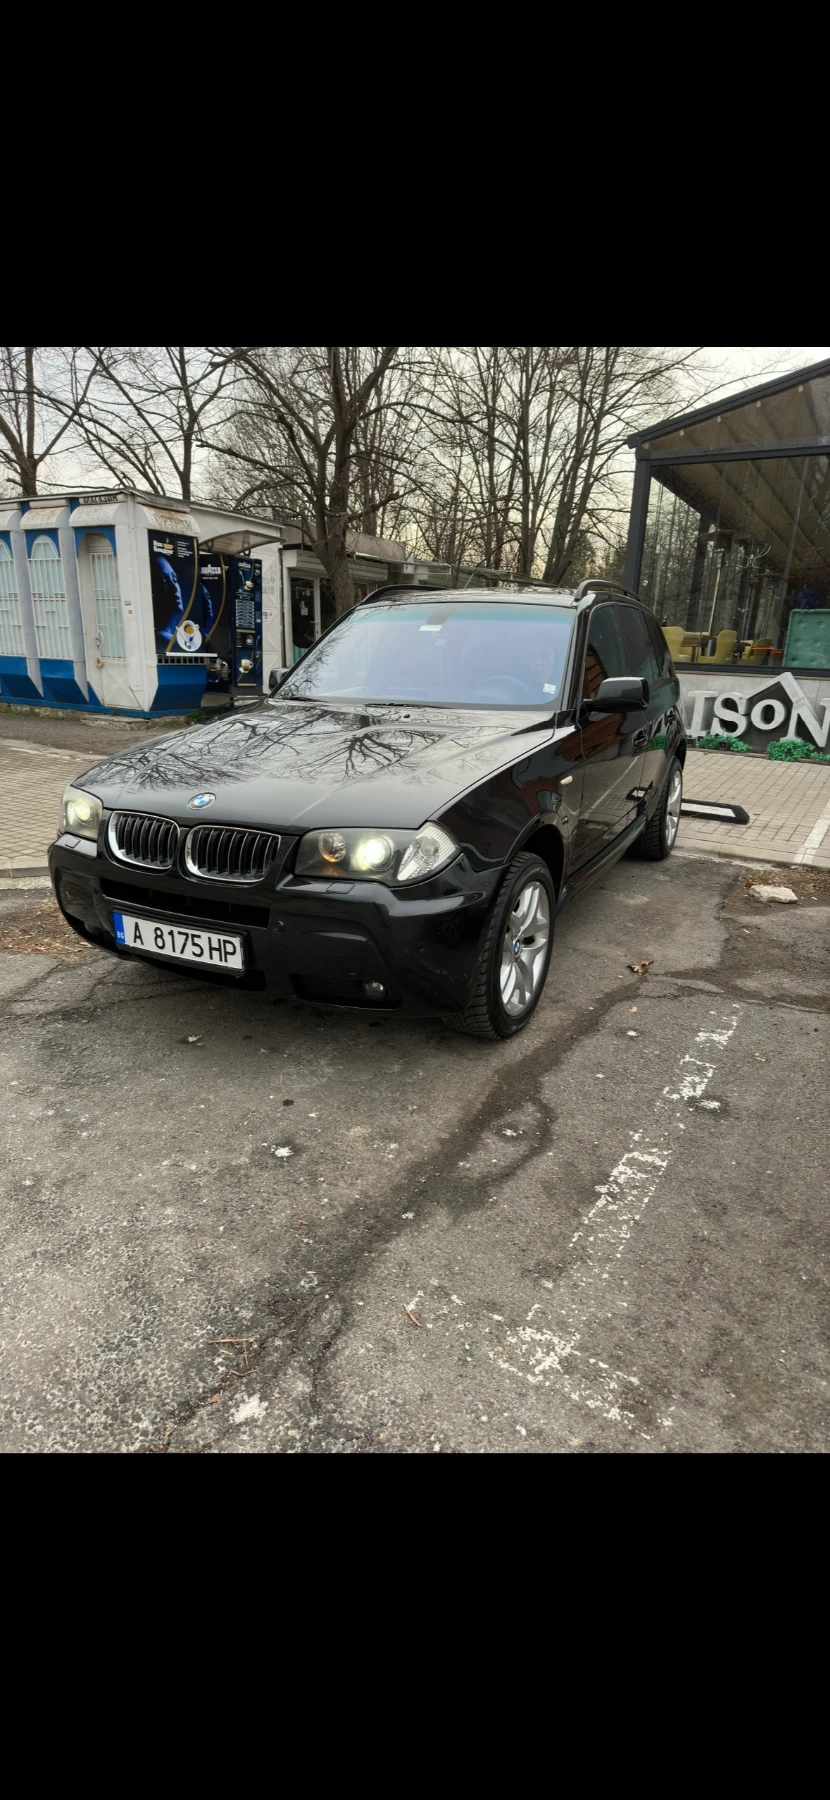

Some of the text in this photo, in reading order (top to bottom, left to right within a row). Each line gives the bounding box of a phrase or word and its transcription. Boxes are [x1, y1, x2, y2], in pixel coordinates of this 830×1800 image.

[116, 931, 125, 940] BG
[133, 921, 237, 963] A 8175 HP
